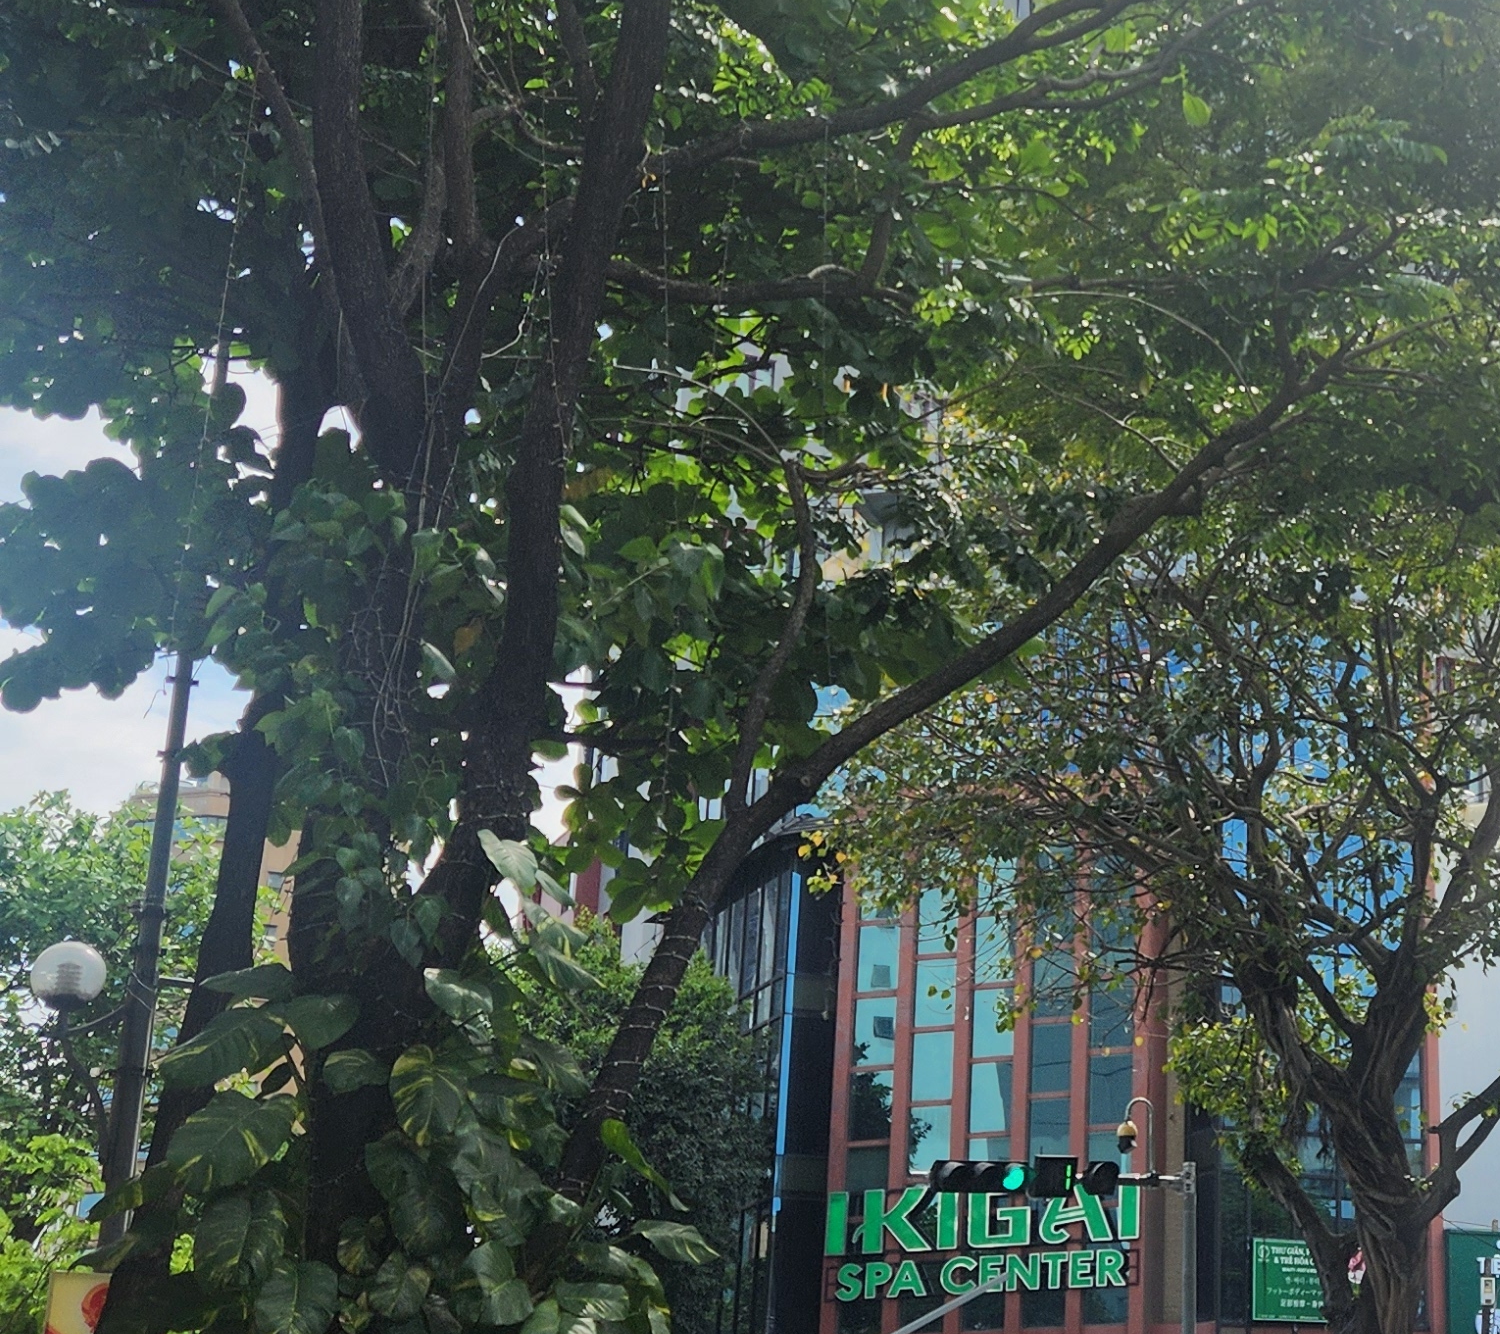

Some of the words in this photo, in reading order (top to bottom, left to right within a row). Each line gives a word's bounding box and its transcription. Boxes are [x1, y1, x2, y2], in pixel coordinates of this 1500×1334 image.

[824, 1185, 1140, 1255] IKIGAI
[834, 1259, 927, 1302] SPA
[939, 1249, 1126, 1295] CENTER
